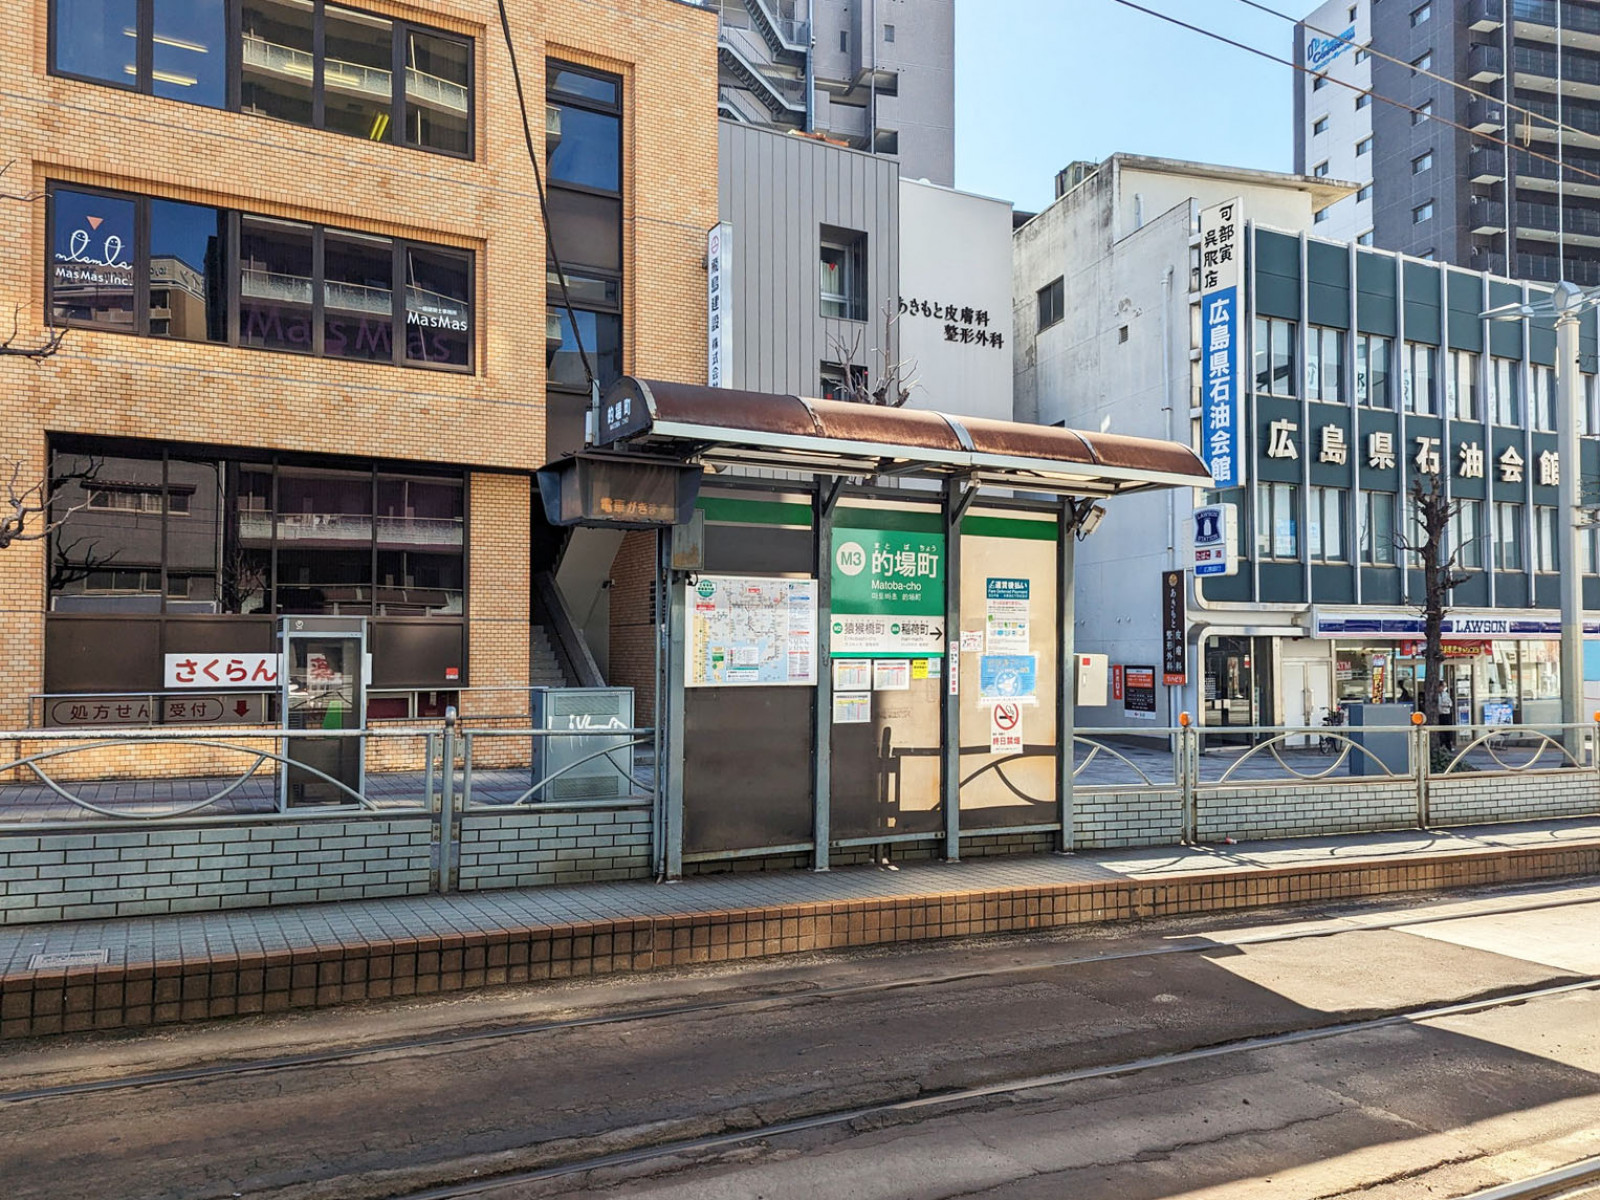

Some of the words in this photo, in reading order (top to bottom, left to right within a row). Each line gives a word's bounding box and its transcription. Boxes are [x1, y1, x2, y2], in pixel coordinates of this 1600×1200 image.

[407, 311, 468, 331] MasMas
[944, 324, 1005, 349] 整形外科
[1209, 299, 1231, 482] 広島県石油会館
[1267, 418, 1559, 486] 広島県石油会館
[840, 551, 862, 566] M3
[871, 550, 939, 578] 的場町
[871, 580, 922, 591] Matoba-cho
[1455, 620, 1508, 633] LAWSON
[175, 658, 278, 682] さくらん
